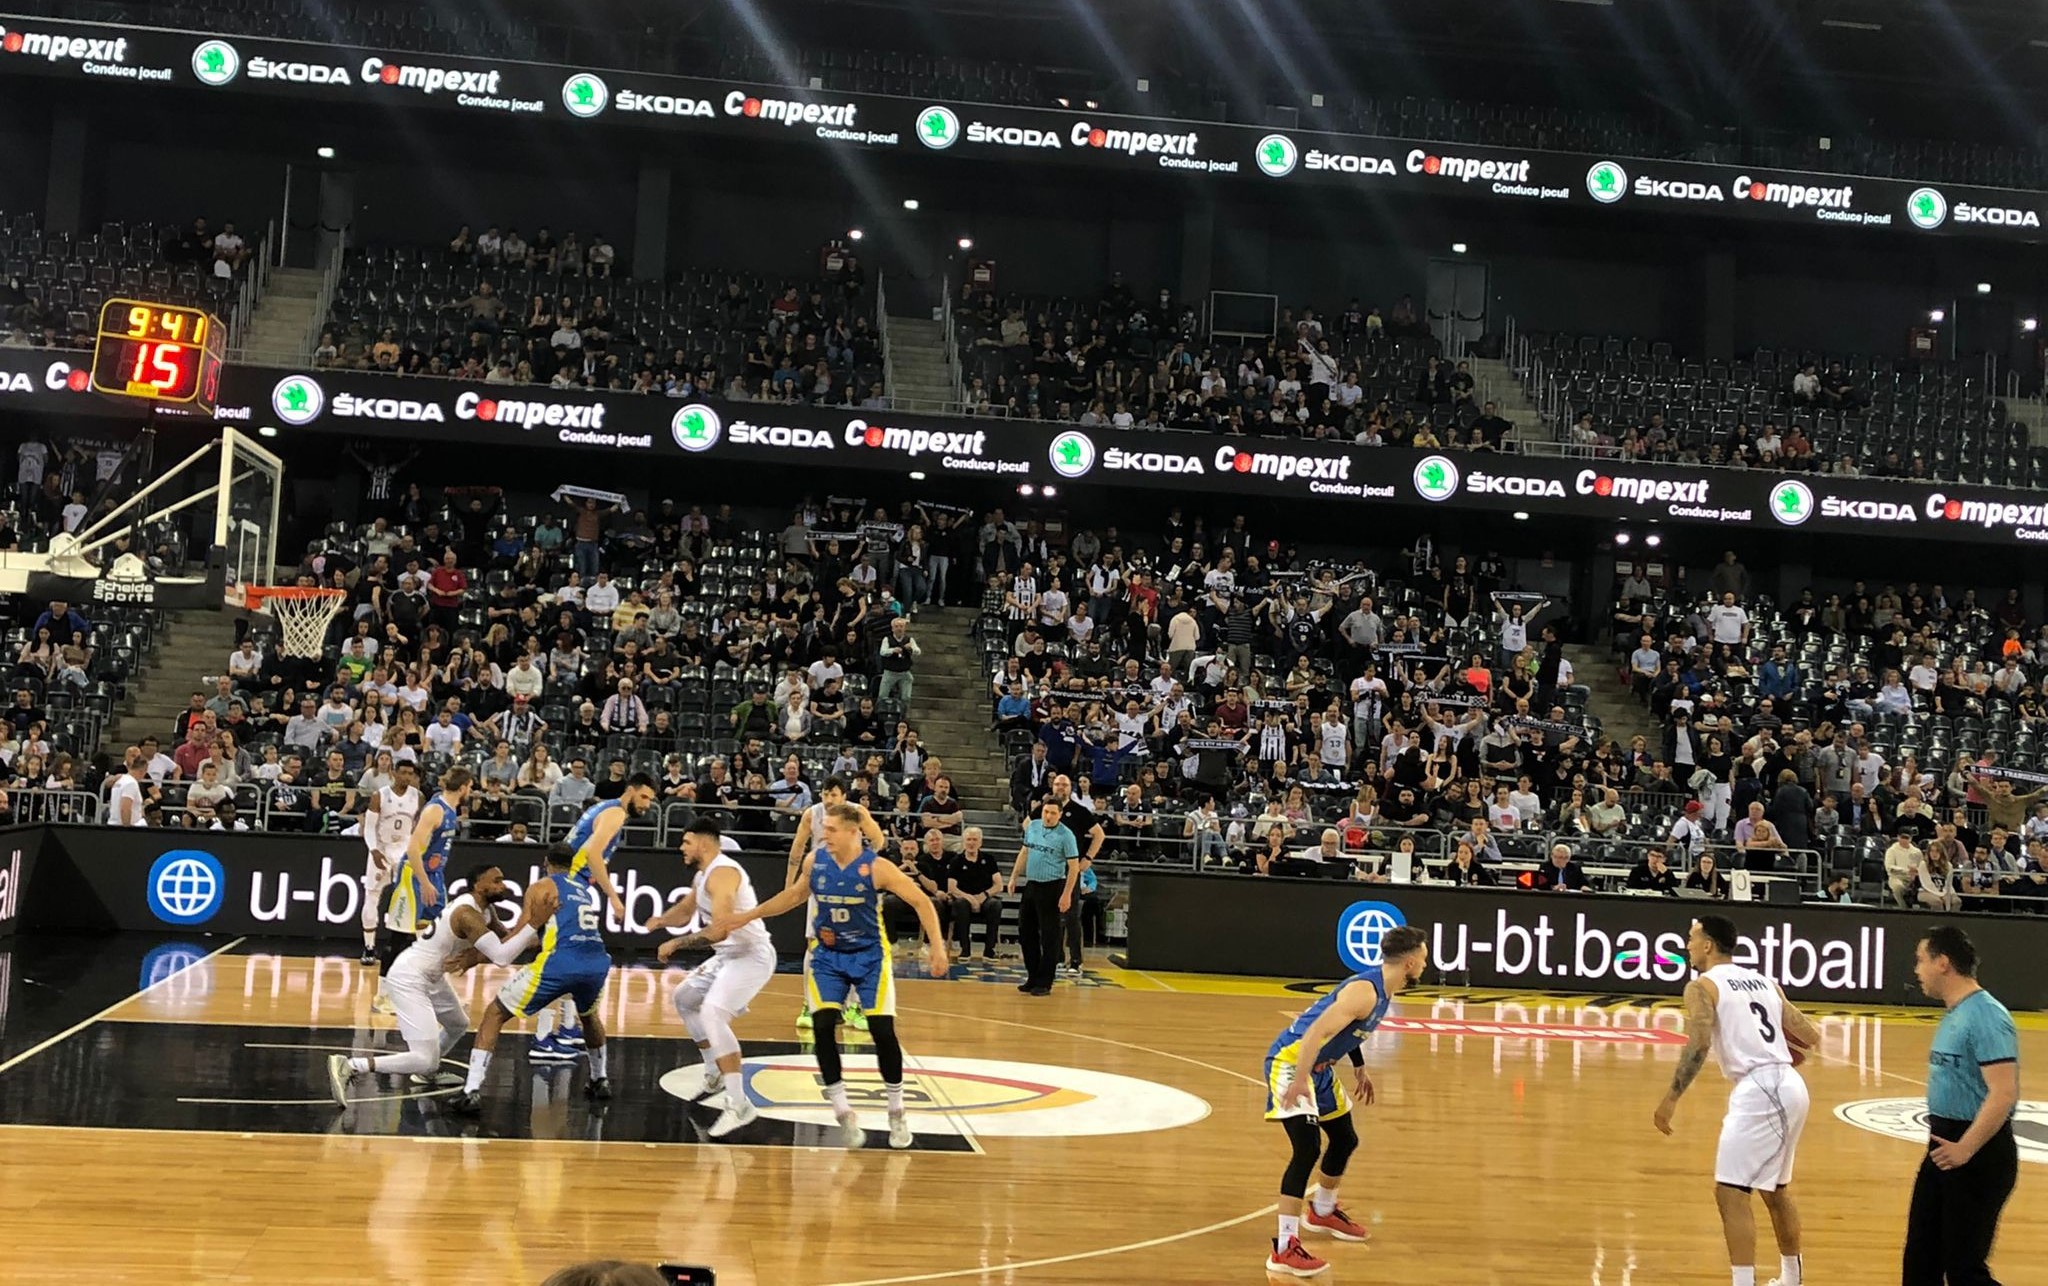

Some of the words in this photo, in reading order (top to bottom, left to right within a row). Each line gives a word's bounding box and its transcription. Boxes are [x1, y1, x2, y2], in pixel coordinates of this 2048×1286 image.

[82, 61, 137, 77] Conduce
[247, 56, 351, 85] ŠKODA
[361, 58, 501, 95] Compexit
[457, 94, 510, 108] Conduce
[616, 89, 714, 117] ŠKODA
[724, 91, 857, 127] Compexit
[816, 126, 866, 141] Conduce
[967, 121, 1061, 148] ŠKODA
[1071, 122, 1198, 156] Compexit
[1159, 156, 1207, 169] Conduce
[1305, 149, 1397, 175] ŠKODA
[1406, 149, 1530, 183] Compexit
[1492, 183, 1539, 196] Conduce
[1635, 176, 1724, 201] ŠKODA
[1733, 175, 1853, 209] Compexit
[1817, 208, 1862, 222] Conduce
[1954, 202, 2041, 227] ŠKODA
[127, 307, 204, 343] 9:41
[133, 343, 180, 389] 15
[332, 392, 445, 422] ŠKODA
[455, 391, 605, 428] Compexit
[559, 429, 616, 445] Conduce
[729, 421, 834, 448] ŠKODA
[845, 419, 986, 457] Compexit
[943, 456, 996, 470] Conduce
[1104, 447, 1204, 474] ŠKODA
[1215, 445, 1351, 481] Compexit
[1310, 481, 1361, 495] Conduce
[1467, 471, 1566, 497] ŠKODA
[1575, 469, 1709, 504] Compexit
[1669, 505, 1719, 518] Conduce
[1821, 495, 1917, 521] ŠKODA
[2015, 528, 2048, 540] Cond
[93, 589, 154, 603] Sports
[829, 907, 851, 923] 10
[1432, 907, 1886, 991] u-bt.basetball
[1749, 1001, 1776, 1044] 3
